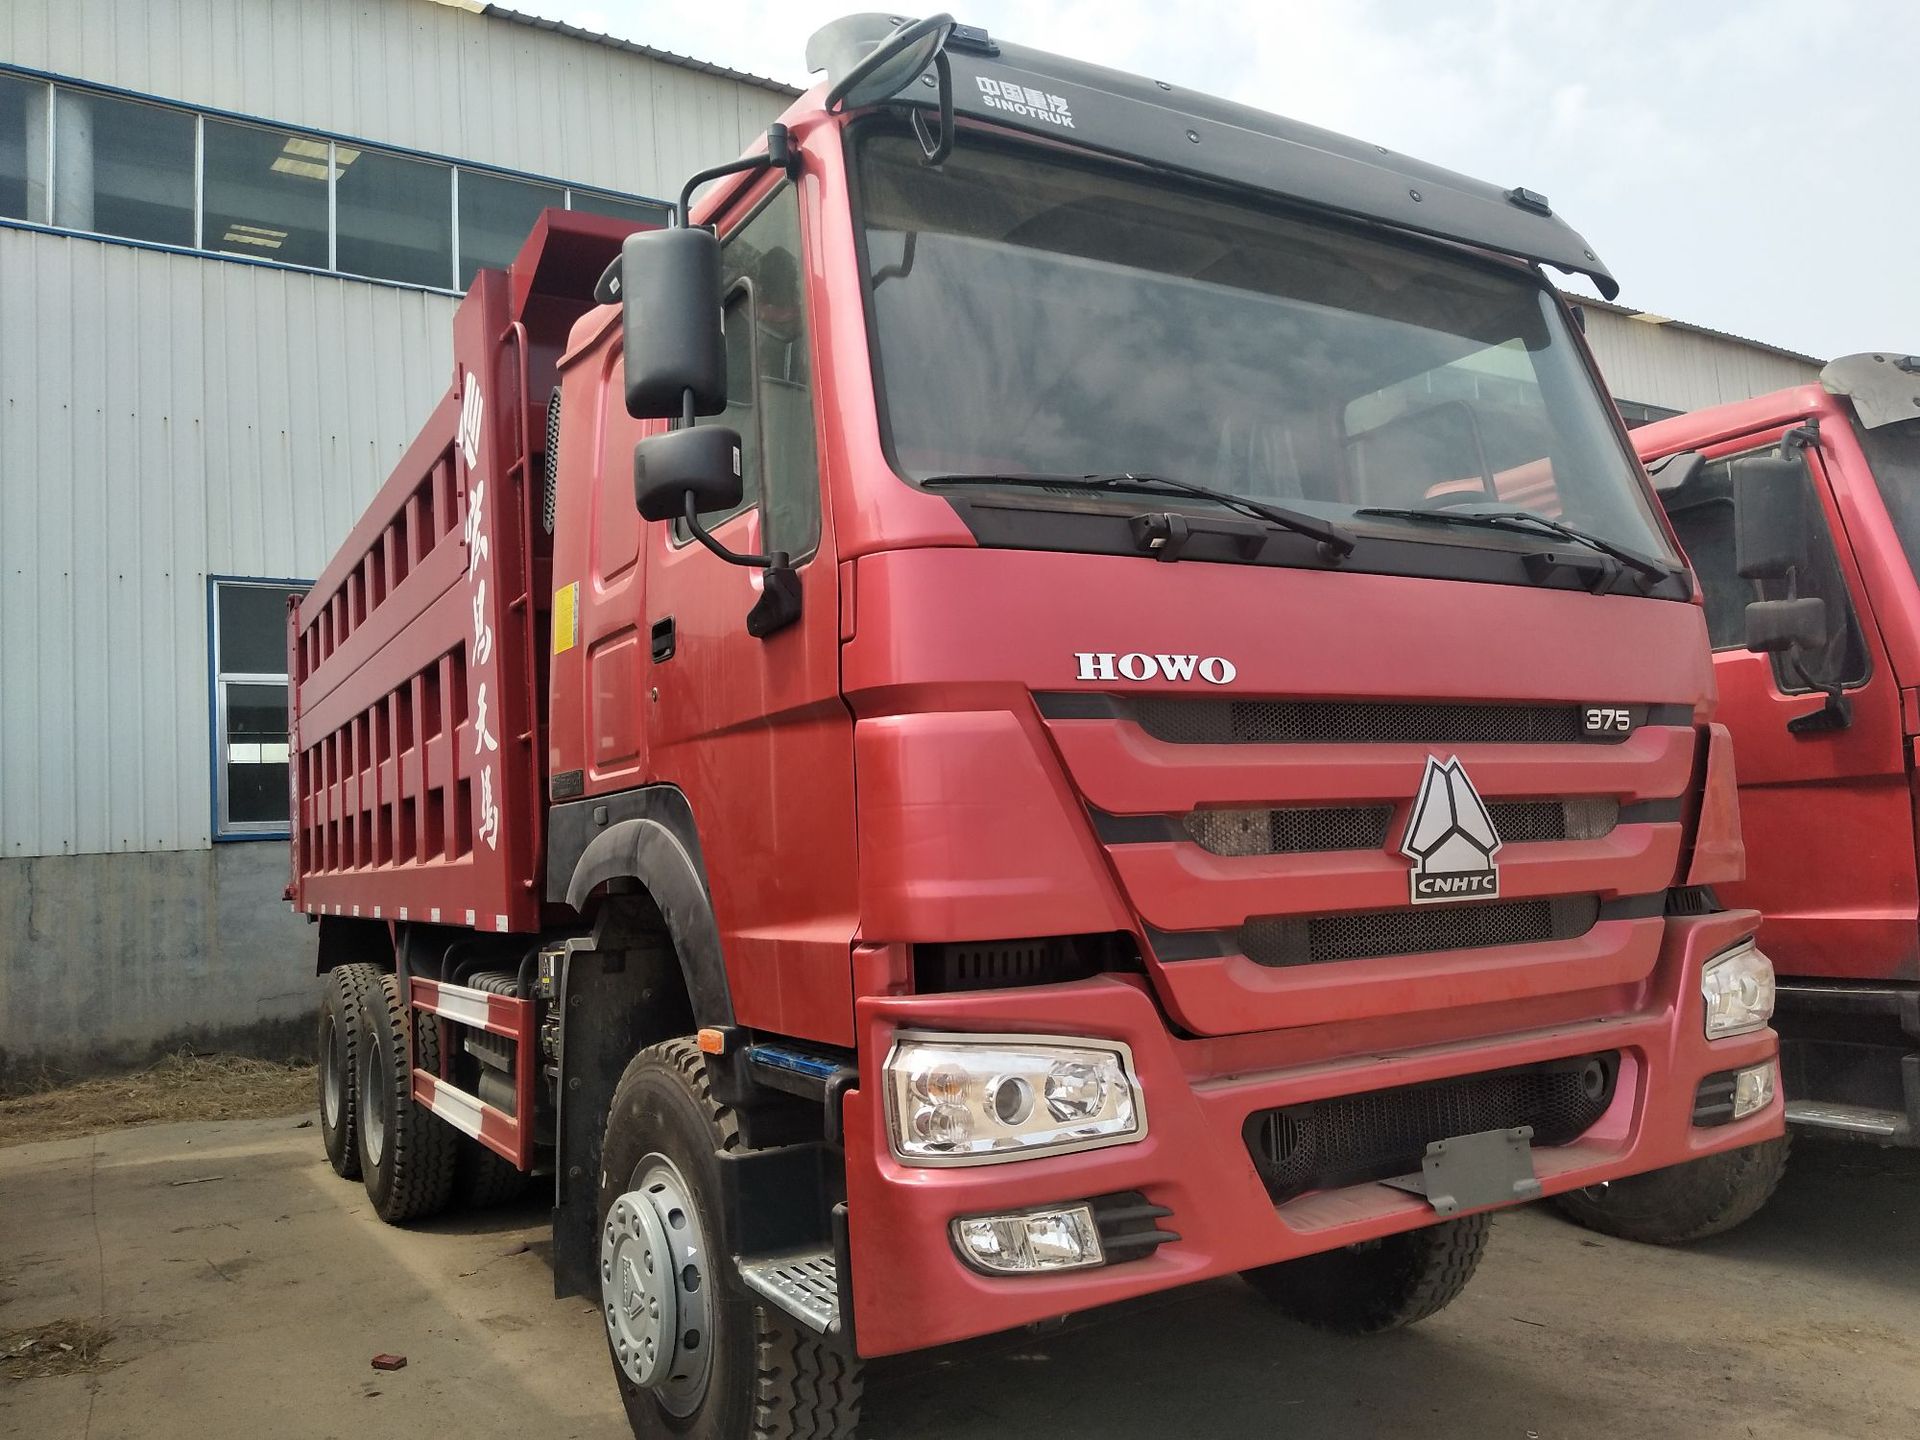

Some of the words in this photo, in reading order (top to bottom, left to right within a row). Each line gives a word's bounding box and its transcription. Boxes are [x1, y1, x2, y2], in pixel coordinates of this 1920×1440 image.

[976, 76, 1072, 116] 中国重汽
[982, 95, 1076, 129] SINOTRUK
[1074, 653, 1237, 684] HOWO
[1586, 709, 1631, 731] 375
[1418, 874, 1495, 893] CNHTC
